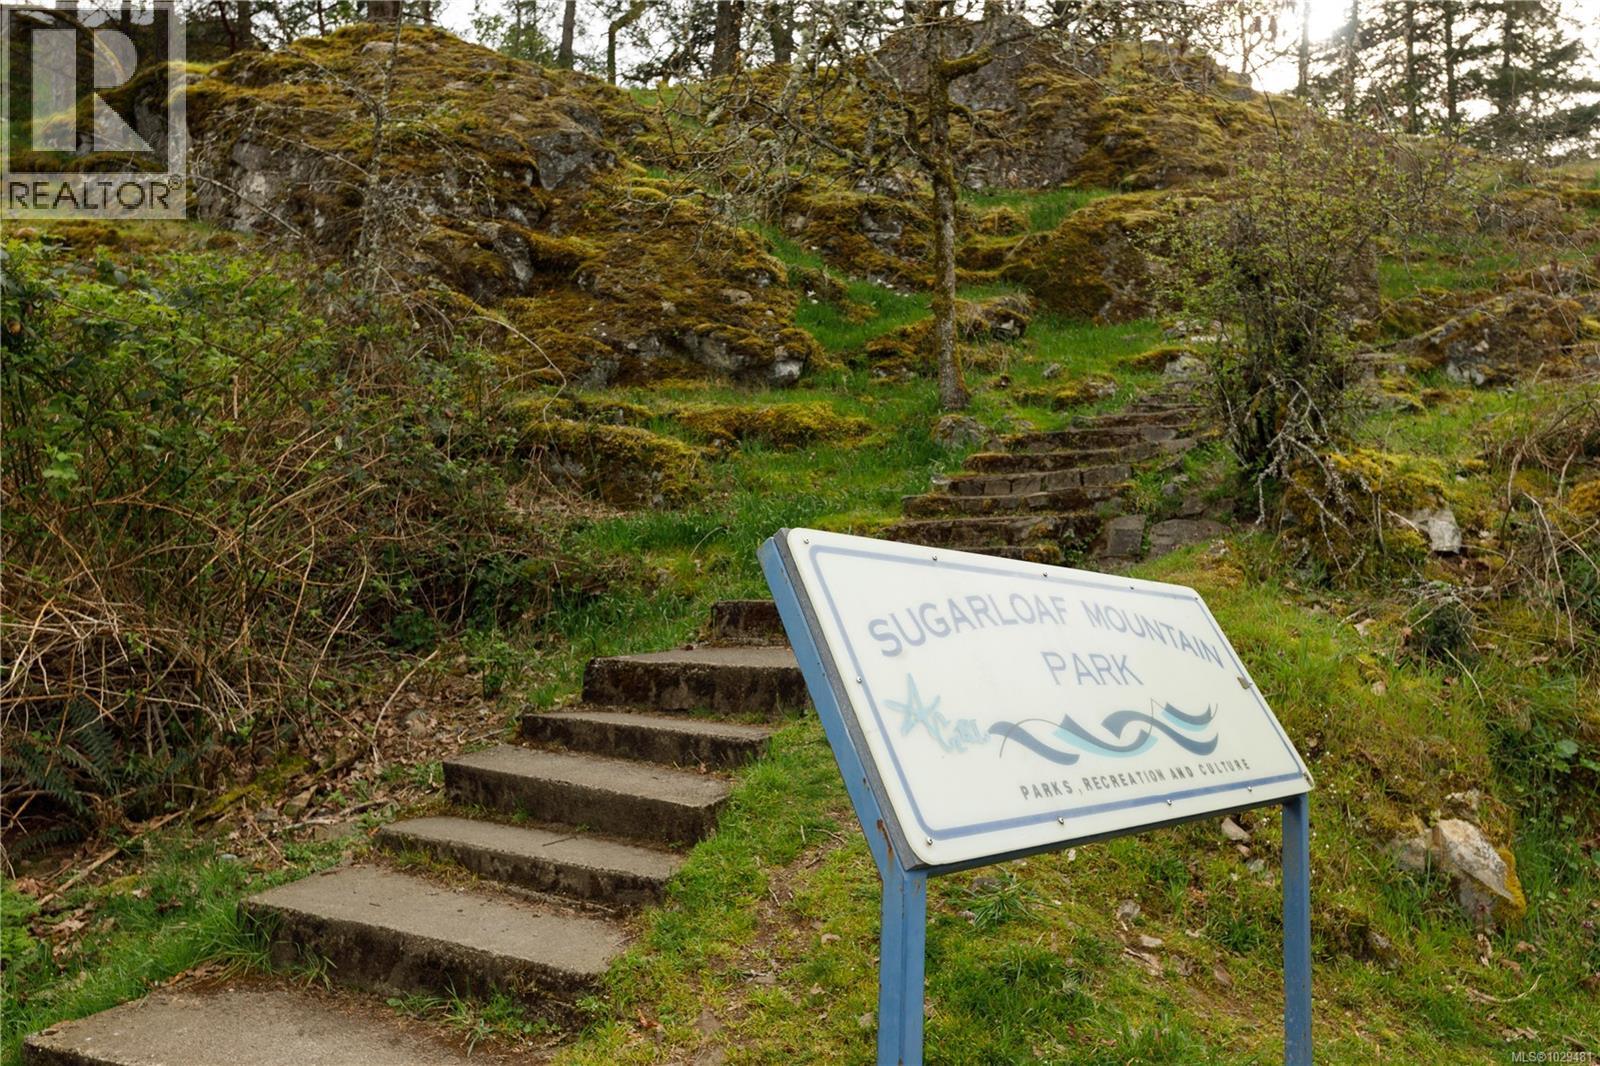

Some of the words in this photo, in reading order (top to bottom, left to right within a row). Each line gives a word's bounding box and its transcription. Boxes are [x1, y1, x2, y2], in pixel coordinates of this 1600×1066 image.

[867, 592, 1067, 657] SUGARLOAF
[1080, 599, 1225, 669] MOUNTAIN
[1040, 651, 1144, 685] PARK
[1082, 768, 1167, 793] RECREATION
[1169, 765, 1195, 780] AND
[1199, 758, 1251, 776] CULTURE
